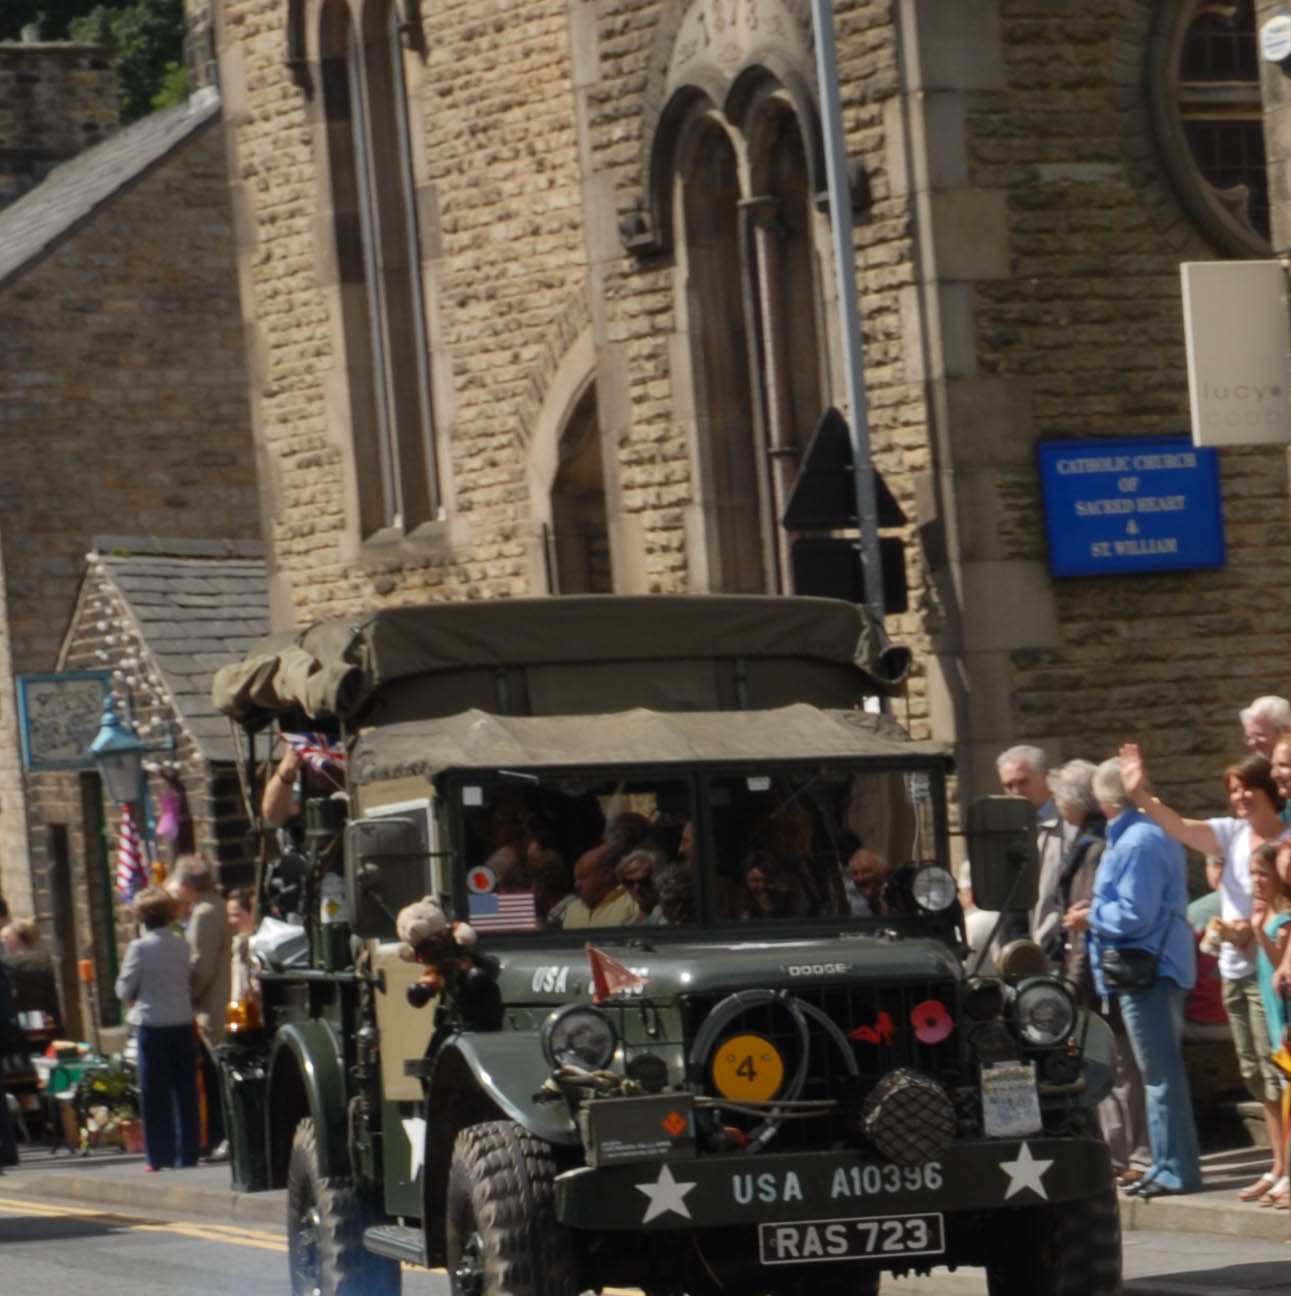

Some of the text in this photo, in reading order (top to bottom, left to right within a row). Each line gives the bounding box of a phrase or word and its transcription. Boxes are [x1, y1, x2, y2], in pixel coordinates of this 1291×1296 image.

[1202, 383, 1266, 404] lucy
[1056, 451, 1197, 475] CATHOLIC CHURCH
[1117, 476, 1140, 493] OF
[531, 965, 570, 994] USA
[787, 962, 849, 977] DODGE
[736, 1055, 758, 1083] 4
[732, 1161, 943, 1204] USA A10396
[773, 1218, 929, 1259] RAS 723
